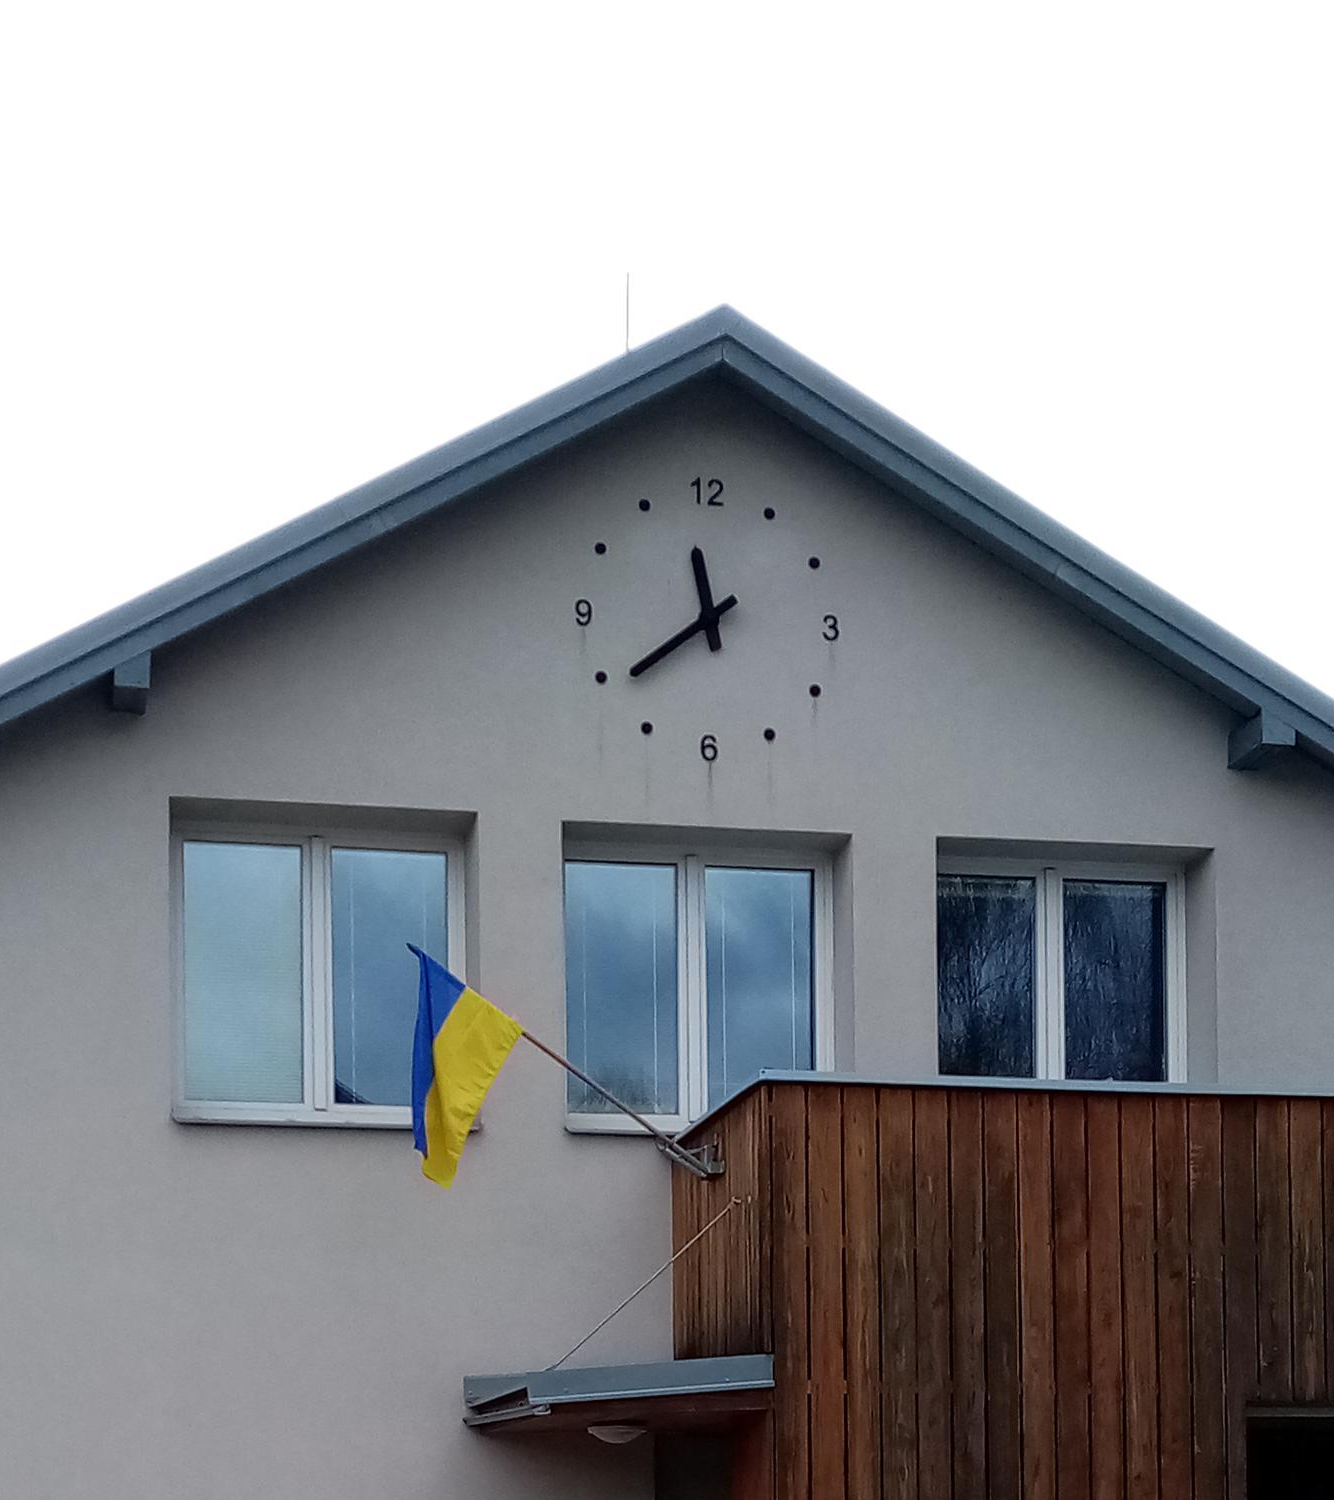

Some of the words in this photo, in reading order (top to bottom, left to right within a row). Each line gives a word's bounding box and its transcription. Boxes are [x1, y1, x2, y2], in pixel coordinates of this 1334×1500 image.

[690, 476, 725, 507] 12
[574, 599, 593, 627] 9
[821, 614, 840, 641] 3
[699, 734, 718, 762] 6
